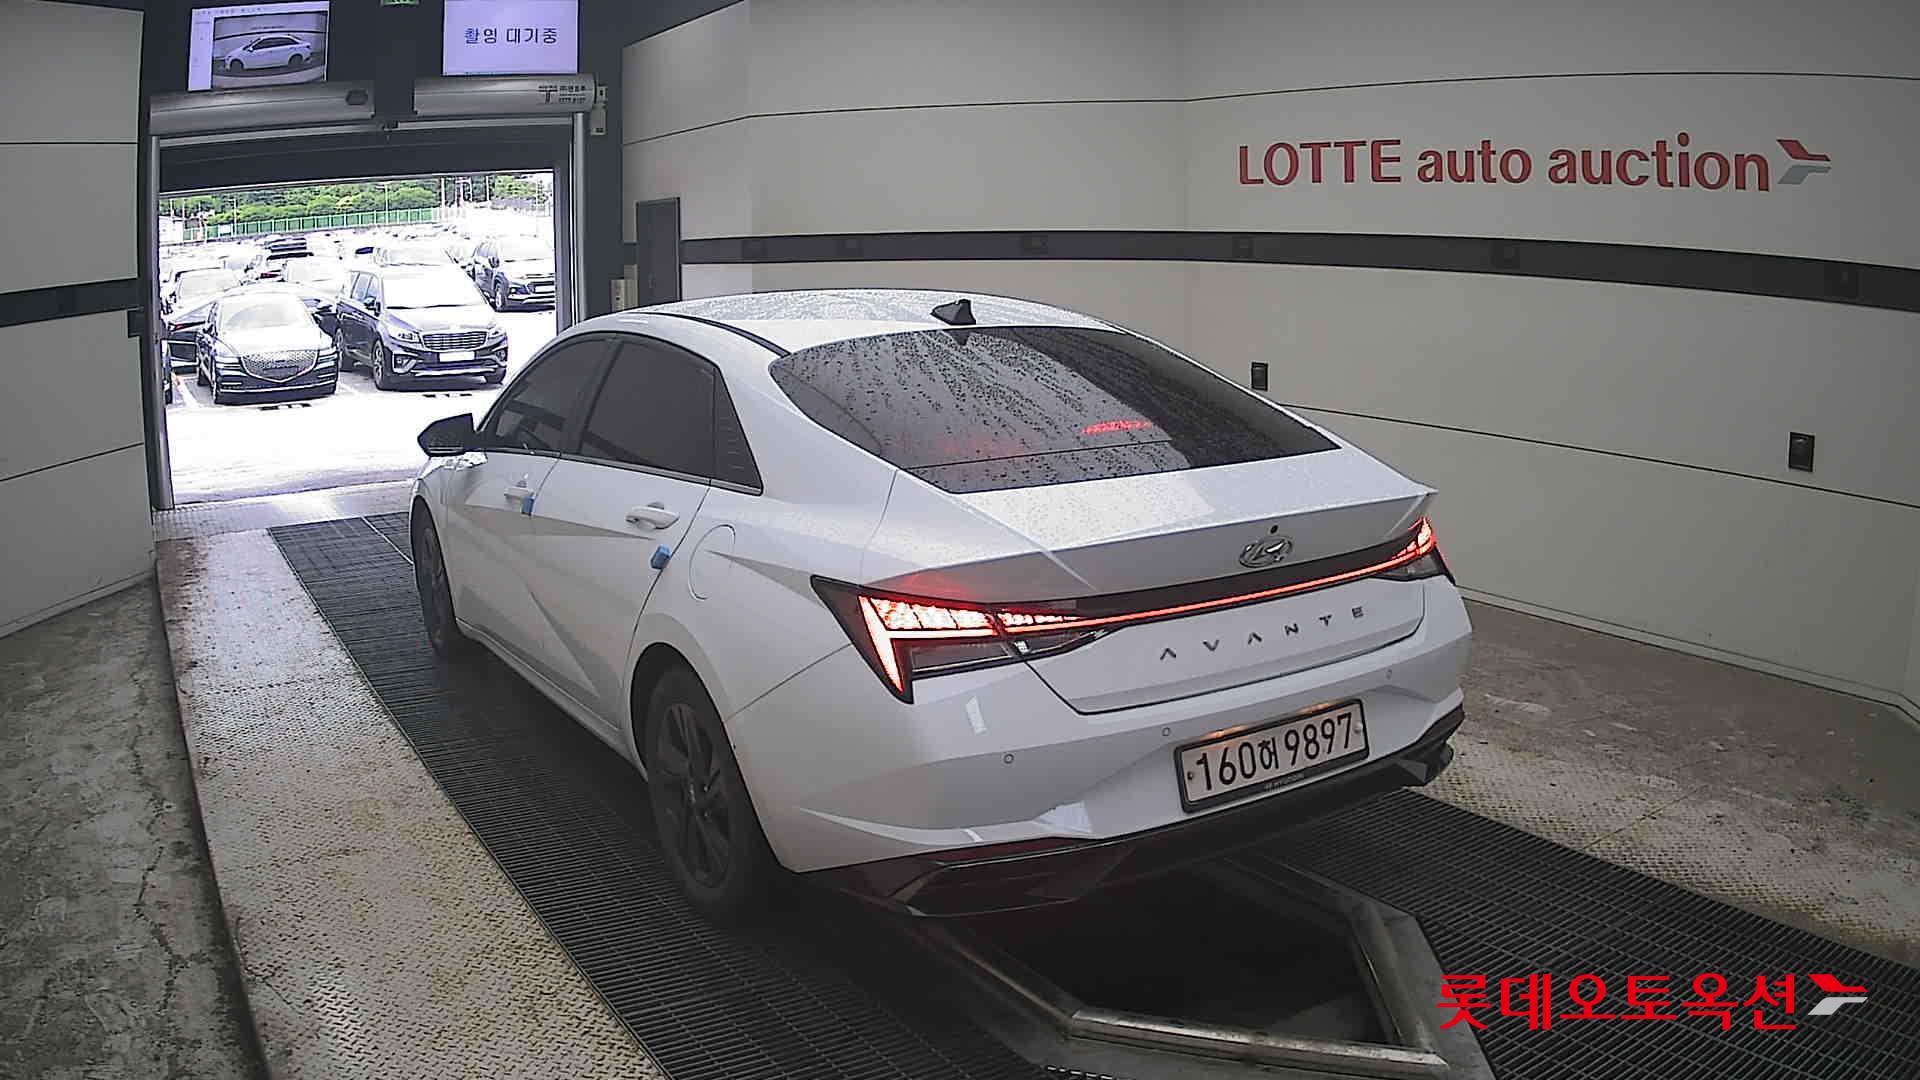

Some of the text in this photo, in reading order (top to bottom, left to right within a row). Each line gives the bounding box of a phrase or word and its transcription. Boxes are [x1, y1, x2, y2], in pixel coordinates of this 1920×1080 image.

[506, 27, 558, 44] 대기중
[1238, 132, 1770, 192] LOTTE auto auction
[1159, 605, 1365, 661] AVANTE
[1284, 711, 1352, 767] 9897
